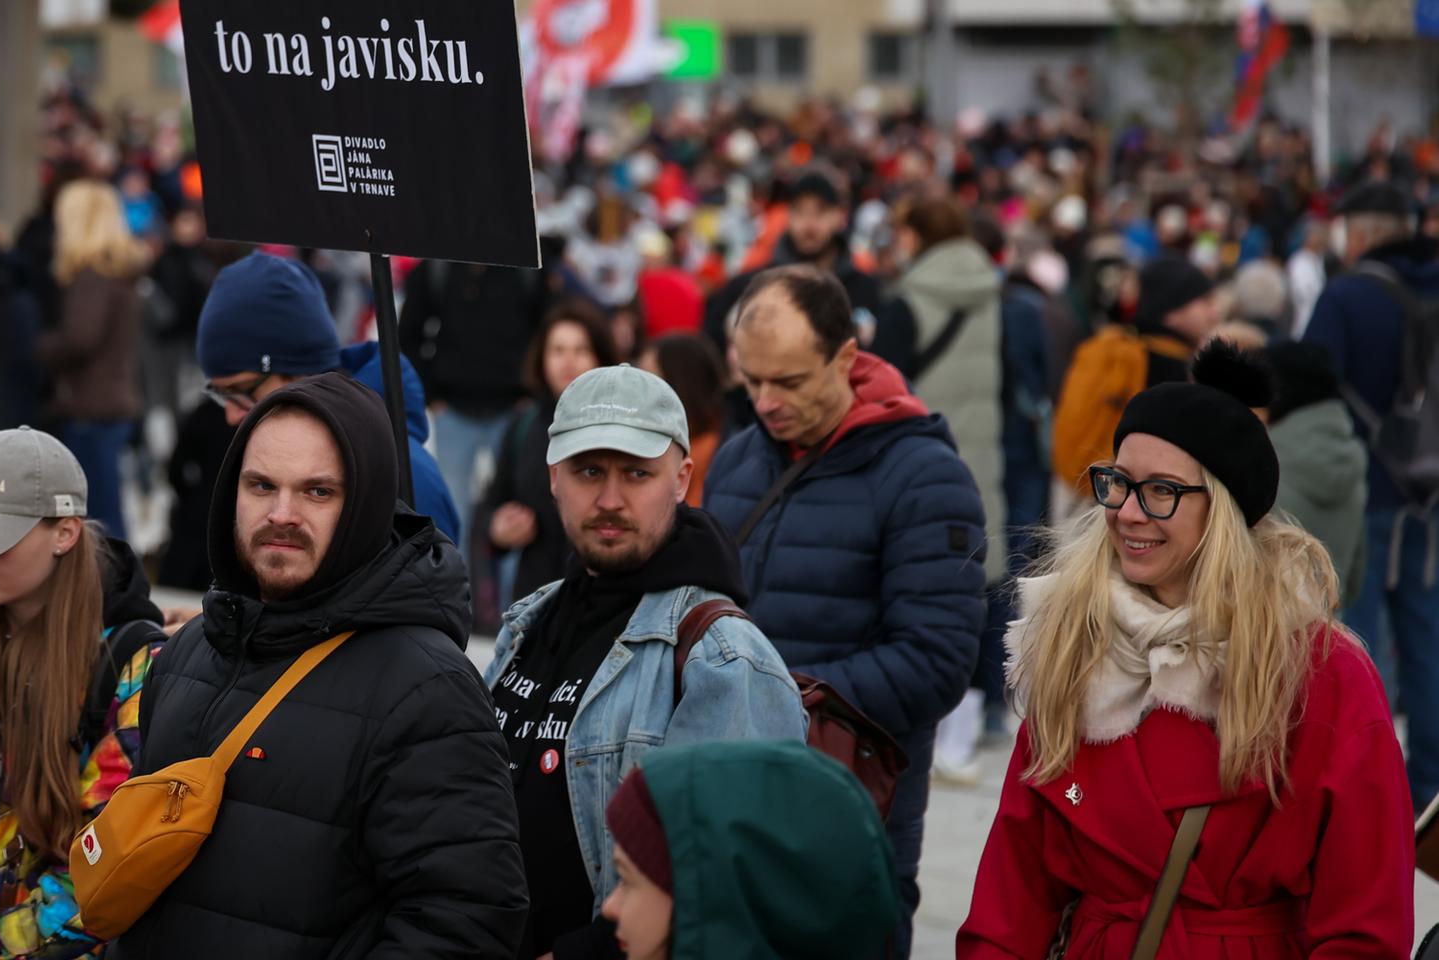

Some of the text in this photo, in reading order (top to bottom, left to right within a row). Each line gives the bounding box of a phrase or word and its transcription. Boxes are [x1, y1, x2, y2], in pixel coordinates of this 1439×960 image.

[213, 15, 485, 92] to na javisku.
[344, 136, 386, 150] DIVADLO
[350, 181, 396, 197] V TRNAVE
